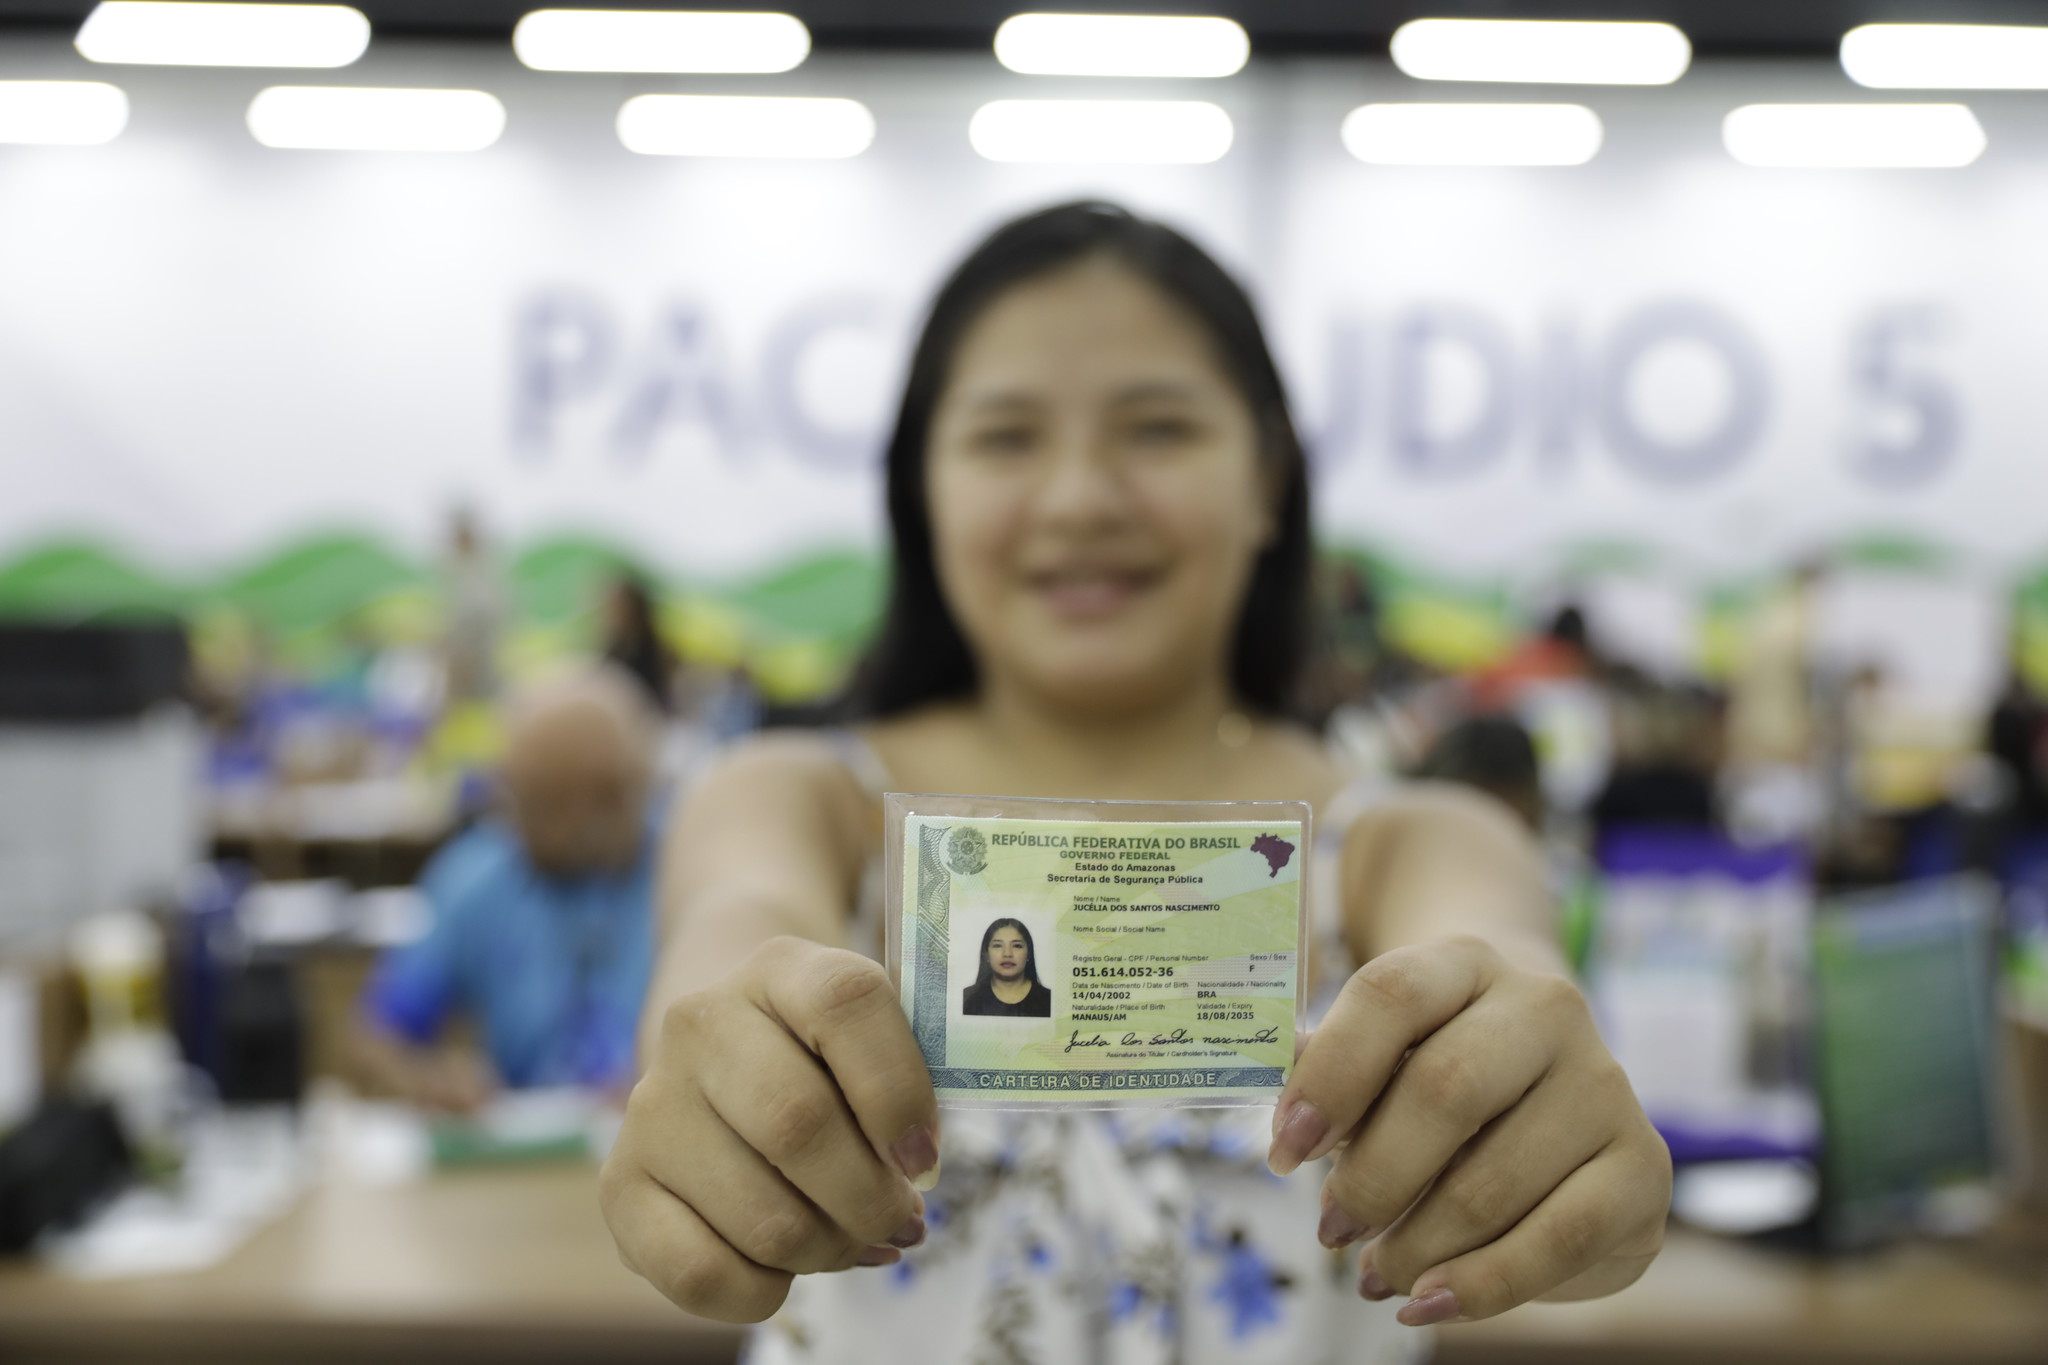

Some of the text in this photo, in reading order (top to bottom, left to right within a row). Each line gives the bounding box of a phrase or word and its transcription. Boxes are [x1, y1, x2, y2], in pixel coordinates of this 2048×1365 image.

[1848, 306, 1960, 492] 5
[992, 831, 1241, 849] REPÚBLICA FEDERATIVA DO BRASIL
[1060, 850, 1171, 860] GOVERNO FEDERAL
[1075, 863, 1176, 872] Estado do Amazonas
[1047, 874, 1203, 885] Secretaria de Segurança Pública
[1073, 902, 1220, 912] JUCÉLIA DOS SANTOS NASCIMENTO
[1072, 955, 1102, 963] Registro
[1072, 967, 1174, 977] 051.614.052-36
[1072, 992, 1131, 1000] 14/04/2002
[1072, 1014, 1127, 1022] MANAUS/AM
[1197, 1012, 1255, 1021] 18/08/2035
[1209, 1050, 1237, 1058] Signature
[979, 1072, 1216, 1088] CARTEIRA DE IDENTIDADE
